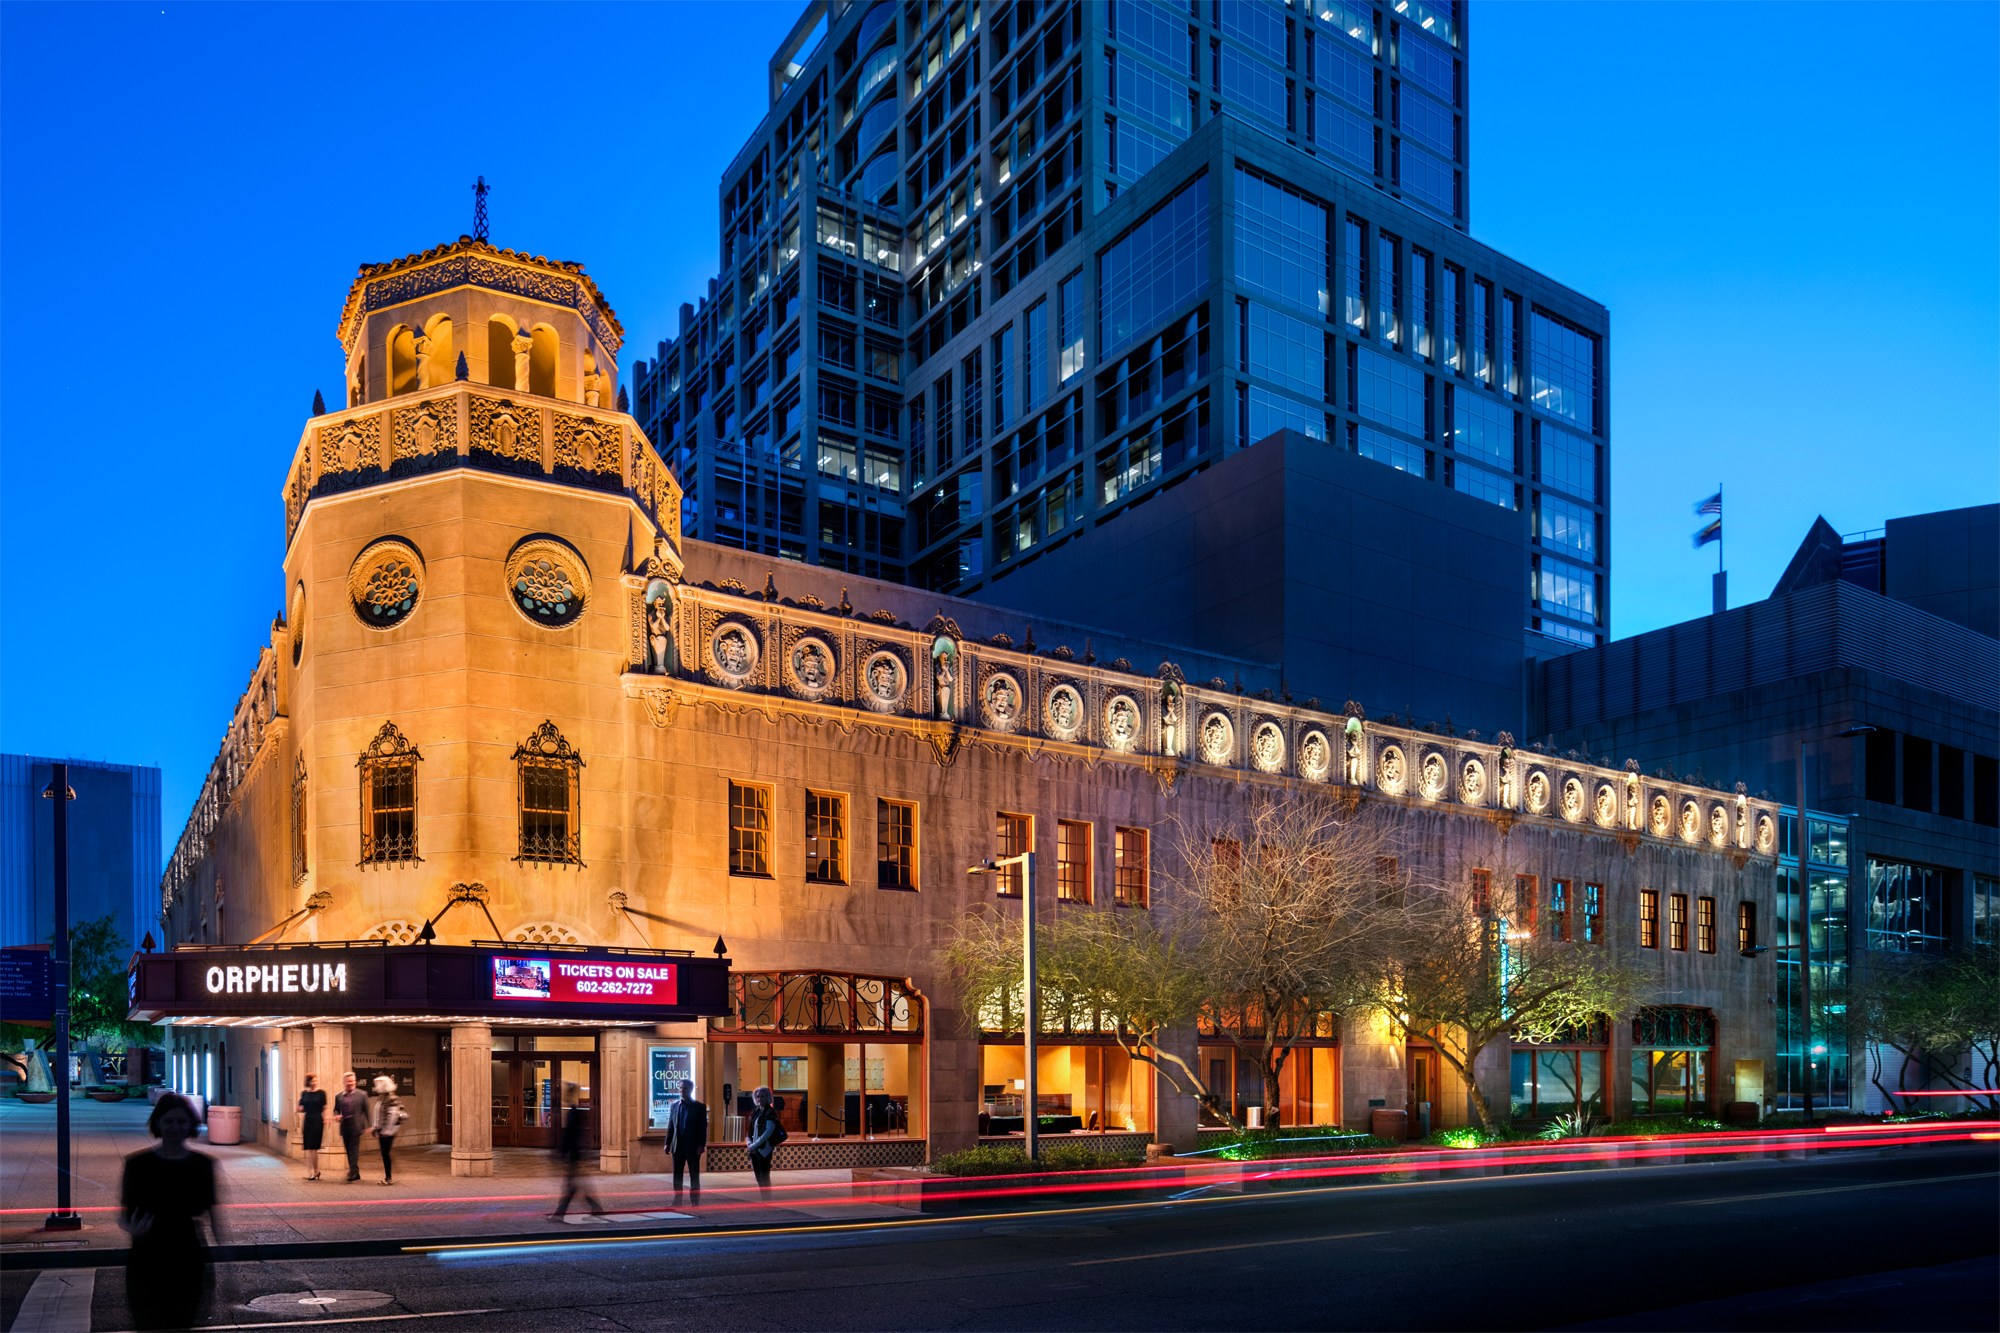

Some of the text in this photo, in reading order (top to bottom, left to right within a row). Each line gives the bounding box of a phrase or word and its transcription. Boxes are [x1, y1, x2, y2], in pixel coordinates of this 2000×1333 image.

[558, 964, 669, 980] TICKETS ON SALE
[206, 963, 347, 994] ORPHEUM
[576, 981, 653, 995] 602-262-7272
[668, 1060, 674, 1070] A
[654, 1070, 689, 1080] CHORUS
[664, 1080, 680, 1090] LINE
